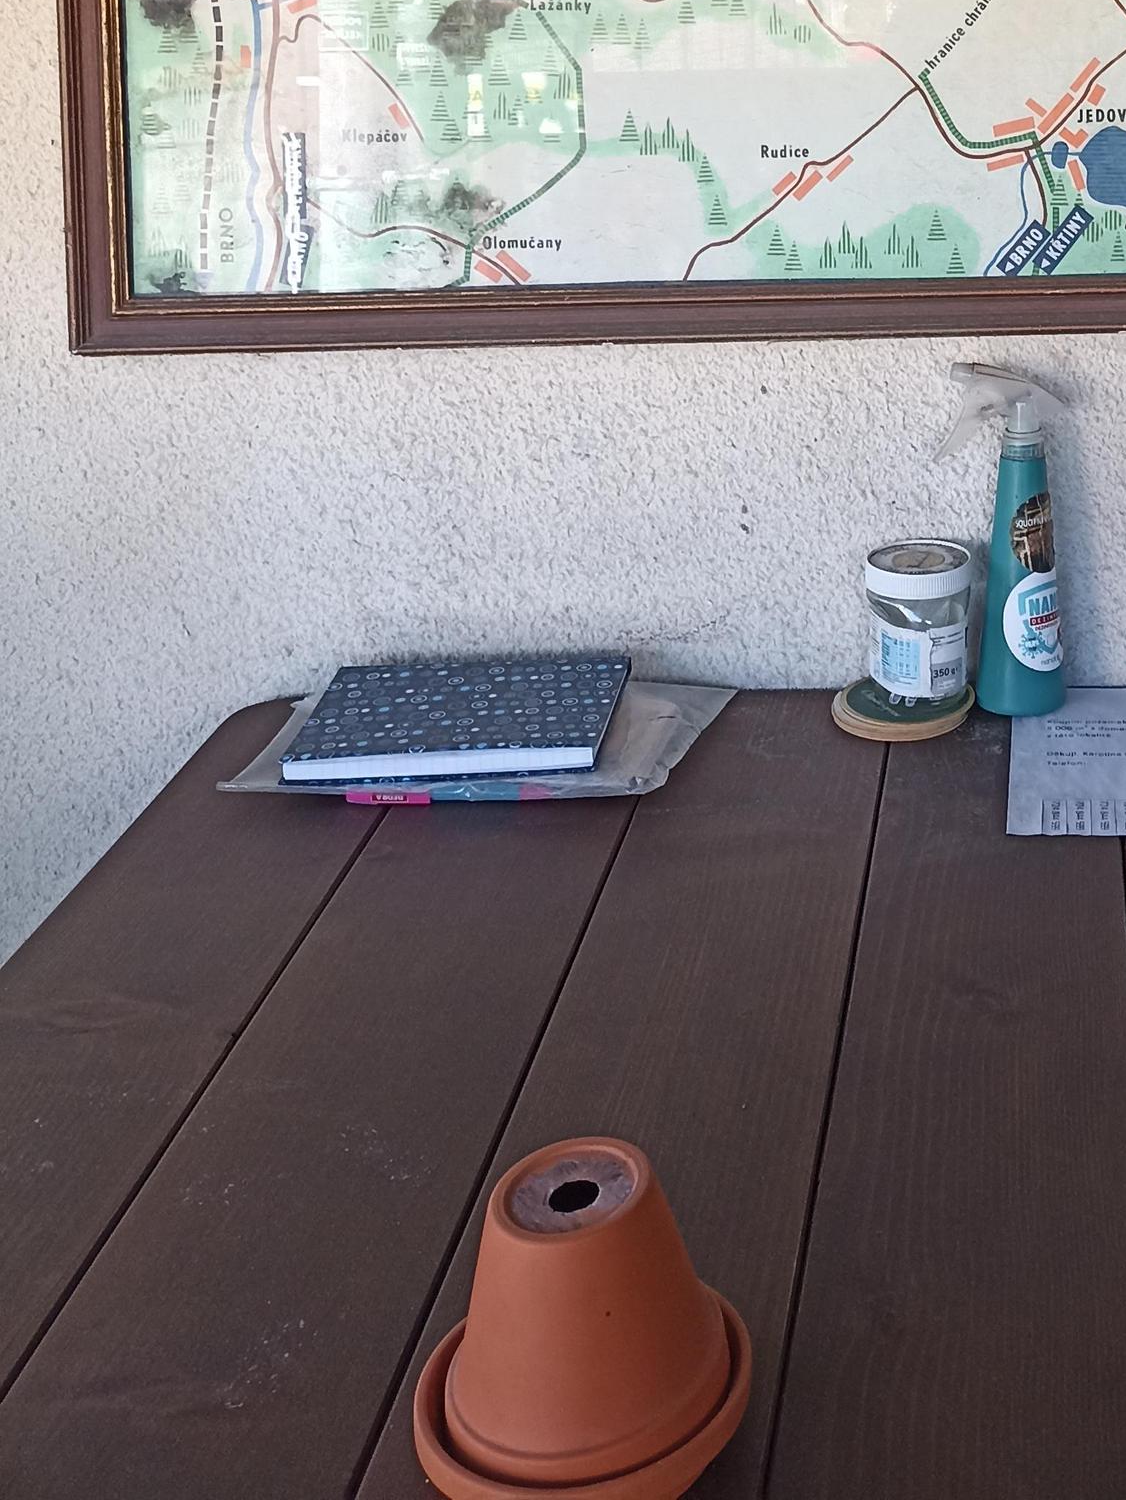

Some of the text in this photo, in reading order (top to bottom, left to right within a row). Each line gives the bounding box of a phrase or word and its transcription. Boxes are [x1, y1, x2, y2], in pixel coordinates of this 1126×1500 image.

[925, 26, 966, 71] hranice
[760, 144, 810, 160] Rudice
[218, 207, 234, 263] BRNO
[482, 235, 563, 252] Olomučany
[1009, 227, 1044, 268] BRNO
[1046, 211, 1087, 261] KŘTINY
[933, 667, 950, 679] 350
